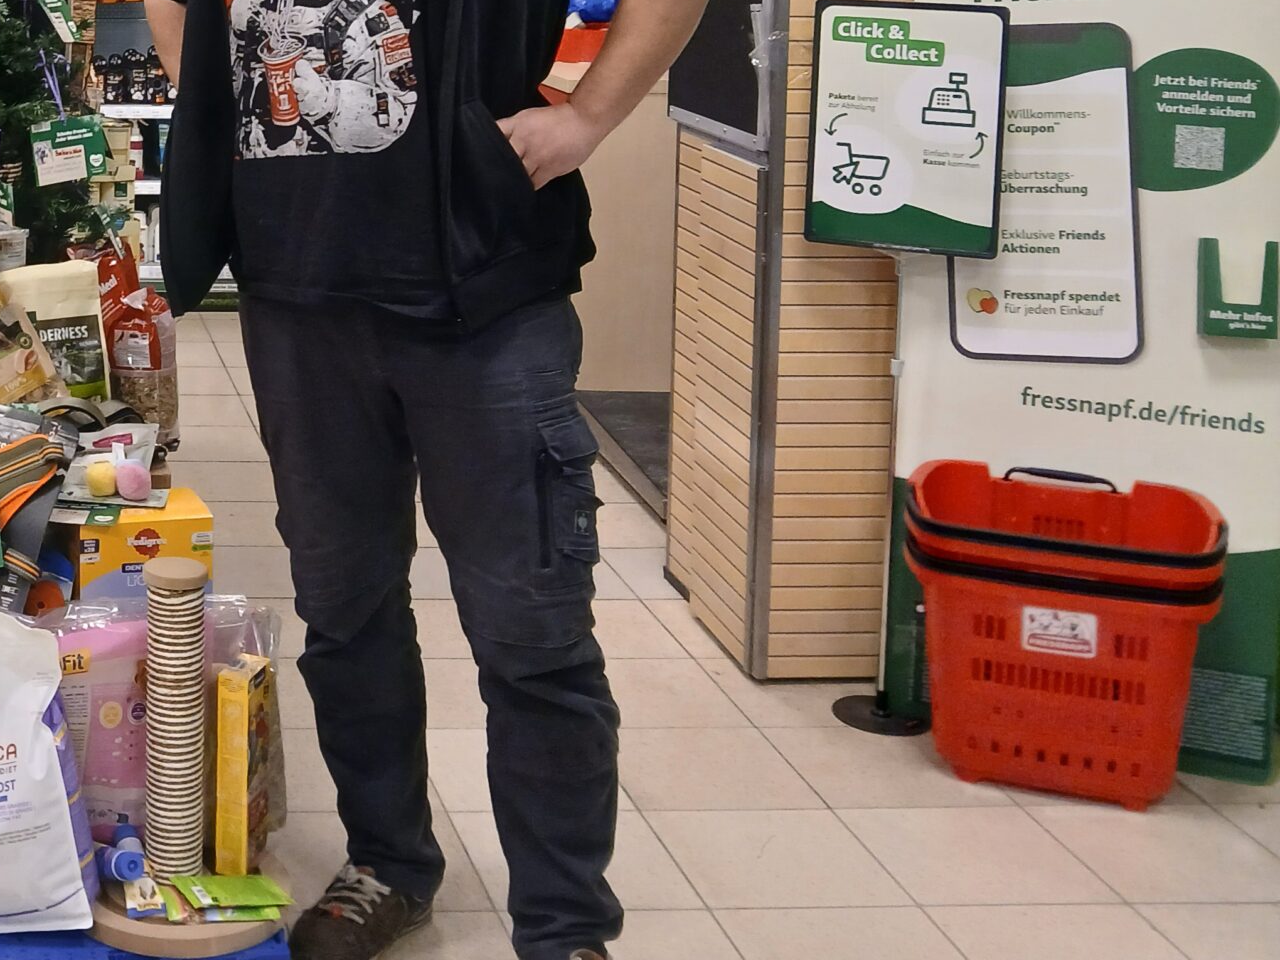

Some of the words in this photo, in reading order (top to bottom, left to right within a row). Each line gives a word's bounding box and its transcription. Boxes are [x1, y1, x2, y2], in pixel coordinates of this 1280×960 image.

[838, 21, 884, 39] Click
[888, 25, 904, 40] &
[870, 44, 939, 62] Collect
[1153, 74, 1185, 86] Jetzt
[1188, 76, 1208, 87] bei
[828, 93, 856, 101] Pakete
[1162, 90, 1224, 102] anmelden
[1227, 94, 1252, 104] und
[1006, 109, 1092, 119] Willkommens-
[1156, 102, 1207, 115] Vorteile
[1209, 106, 1256, 118] sichern
[1001, 229, 1055, 240] Exklusive
[1058, 230, 1105, 240] Friends
[1001, 243, 1060, 254] Aktionen
[1004, 290, 1066, 302] Fressnapf
[1068, 292, 1121, 304] spendet
[1004, 303, 1021, 314] für
[1024, 304, 1056, 316] jeden
[1060, 305, 1104, 316] Einkauf
[39, 326, 88, 342] DERNESS
[1021, 386, 1266, 435] fressnapf.de/friends
[61, 653, 84, 671] Fit
[0, 765, 17, 775] DIET
